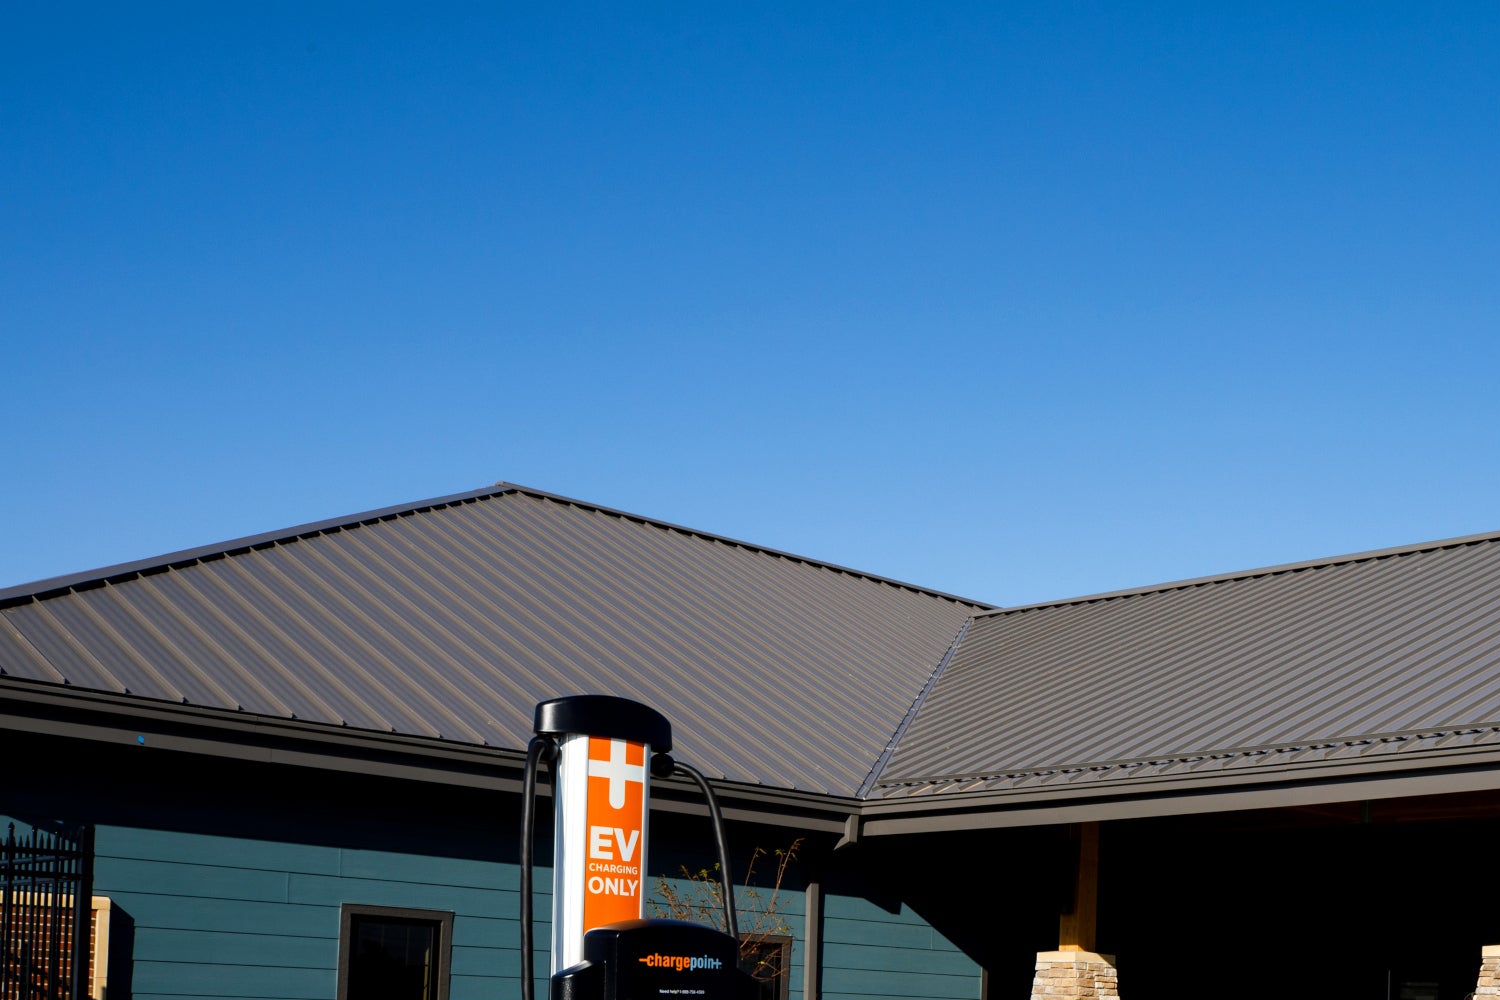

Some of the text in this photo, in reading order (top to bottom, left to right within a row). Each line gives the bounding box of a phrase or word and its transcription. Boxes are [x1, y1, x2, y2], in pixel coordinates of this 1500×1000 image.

[589, 825, 640, 862] EV
[589, 863, 638, 875] CHARGING
[588, 876, 639, 897] ONLY
